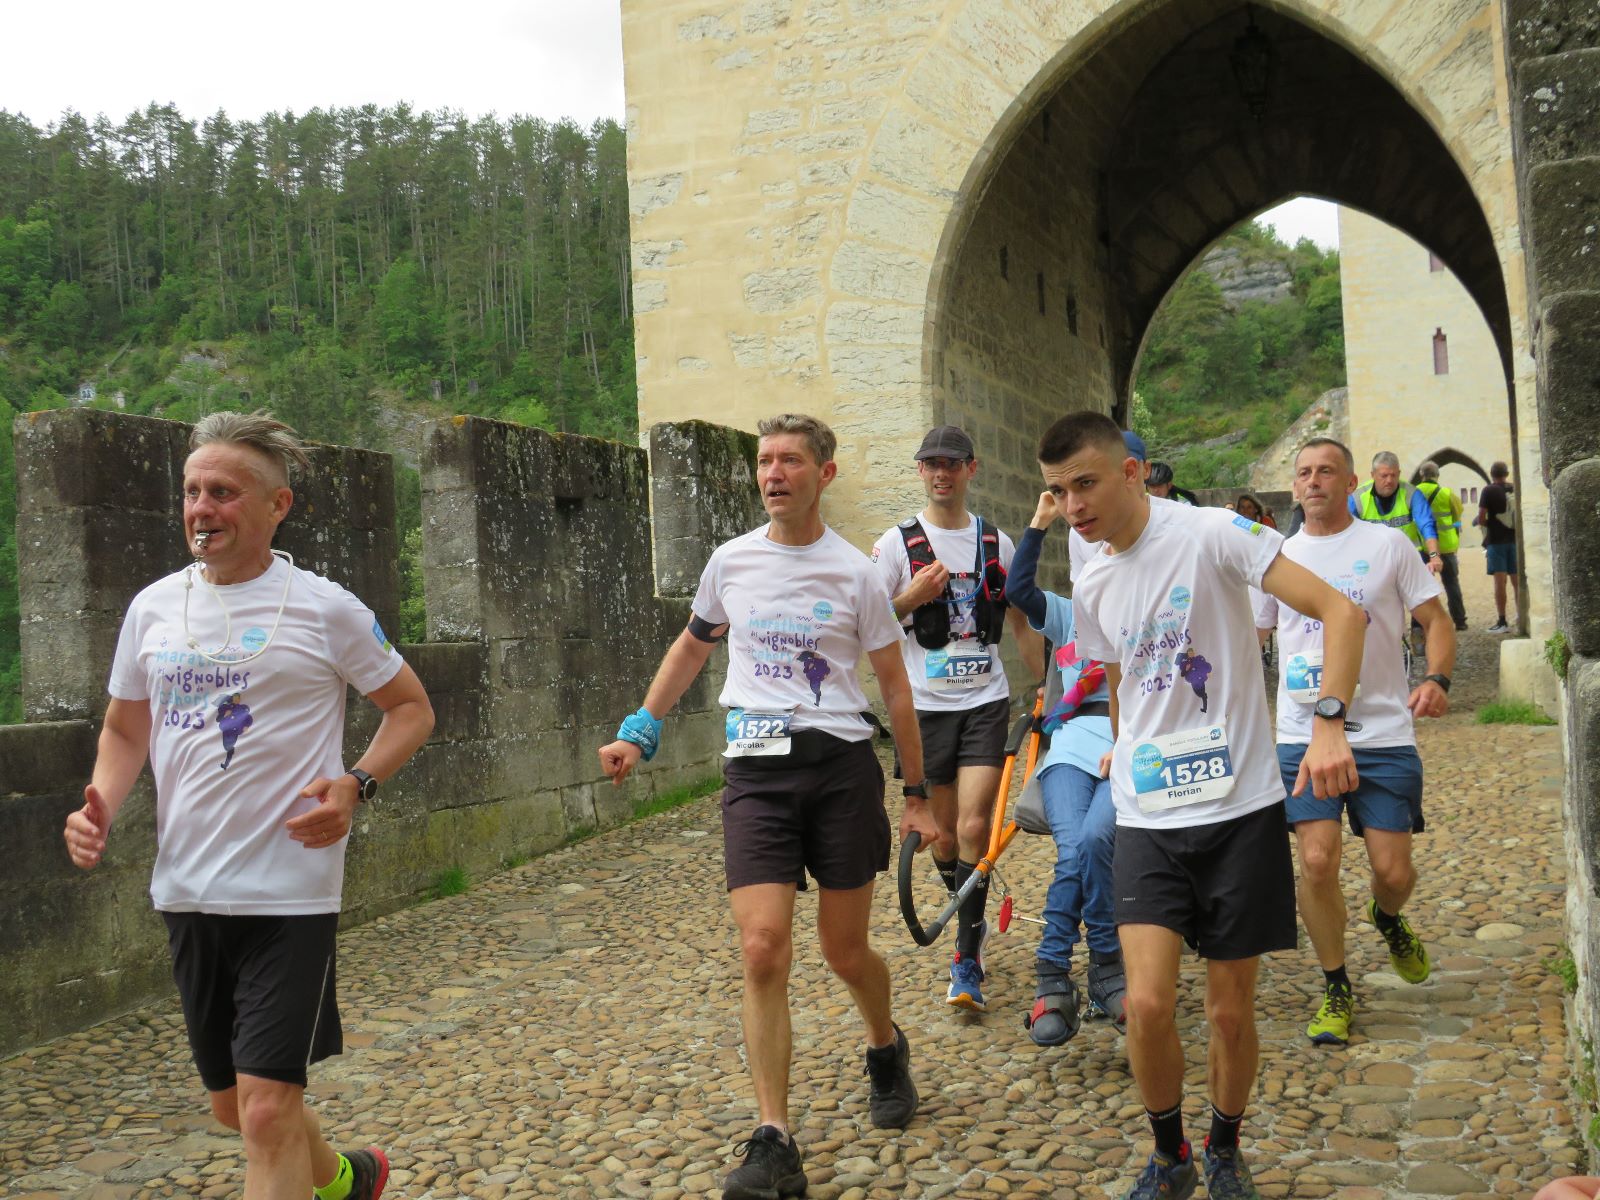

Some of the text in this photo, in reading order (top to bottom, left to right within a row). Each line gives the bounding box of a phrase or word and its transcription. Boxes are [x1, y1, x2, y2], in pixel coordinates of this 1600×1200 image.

[754, 663, 793, 680] 2023
[944, 660, 989, 677] 1527
[165, 665, 250, 692] vignobles
[165, 710, 205, 729] 2023
[736, 719, 785, 739] 1522
[735, 741, 765, 749] Nicolas
[1159, 756, 1226, 787] 1528
[1167, 786, 1202, 799] Florian
